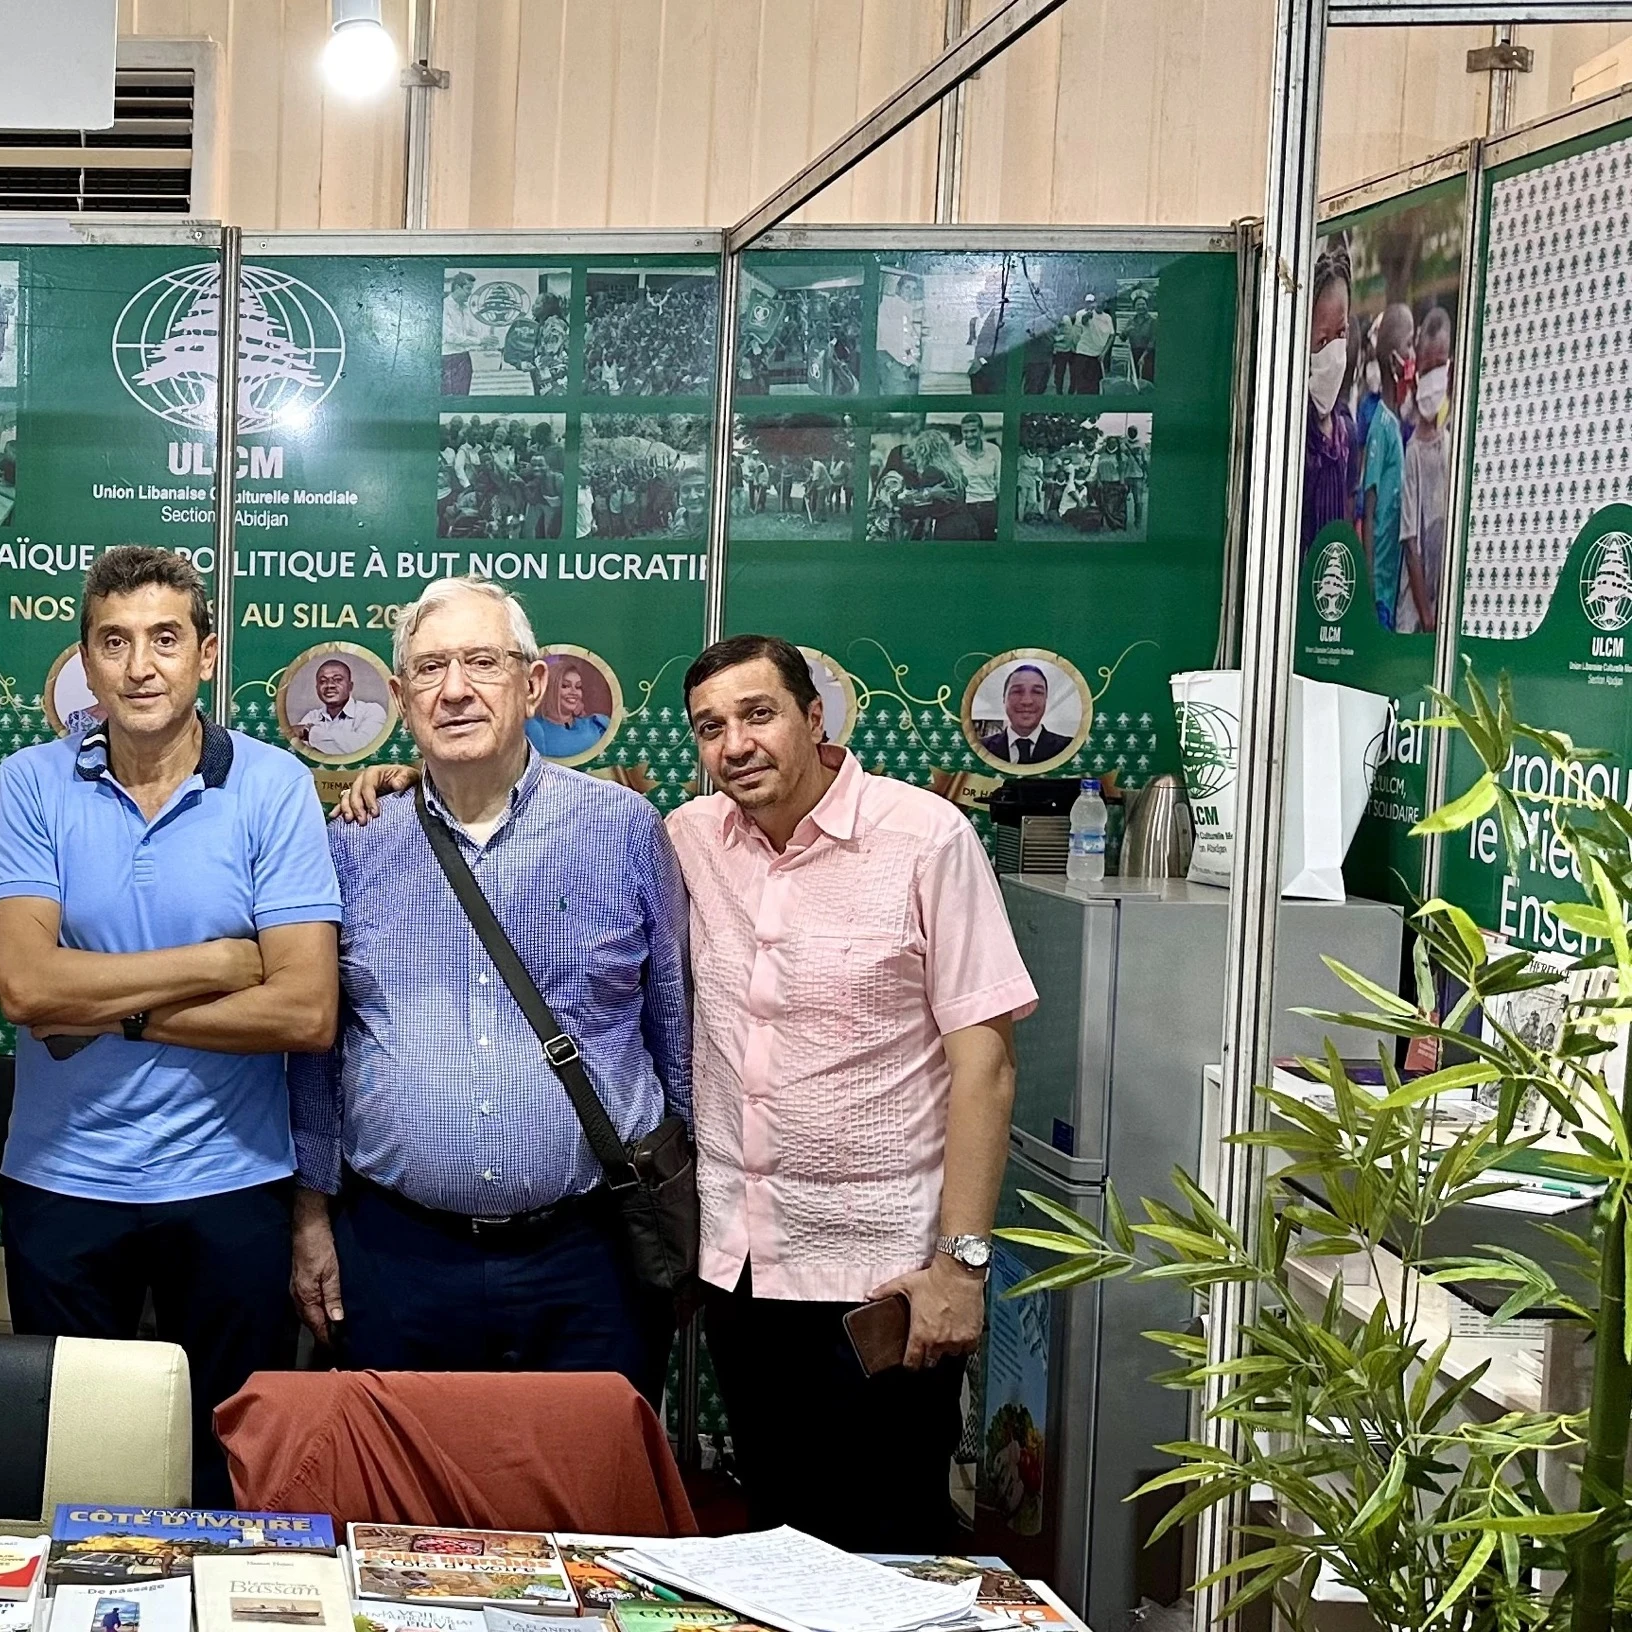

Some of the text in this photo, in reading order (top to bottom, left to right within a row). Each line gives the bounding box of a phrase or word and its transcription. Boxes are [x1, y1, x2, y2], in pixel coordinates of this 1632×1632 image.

[93, 484, 134, 500] Union
[138, 485, 206, 501] Libanaise
[294, 490, 358, 504] Mondiale
[161, 506, 289, 529] Section Abidjan
[363, 545, 388, 578] À
[397, 552, 461, 579] BUT
[469, 553, 547, 579] NON
[9, 595, 76, 622] NOS
[241, 604, 284, 628] AU
[292, 604, 359, 628] SILA
[1320, 626, 1341, 642] ULCM
[1591, 636, 1625, 658] ULCM
[962, 787, 977, 797] DR
[1469, 816, 1499, 865] le
[69, 1508, 153, 1526] CÔTE
[87, 1583, 165, 1597] De passage
[229, 1580, 321, 1596] Bassam
